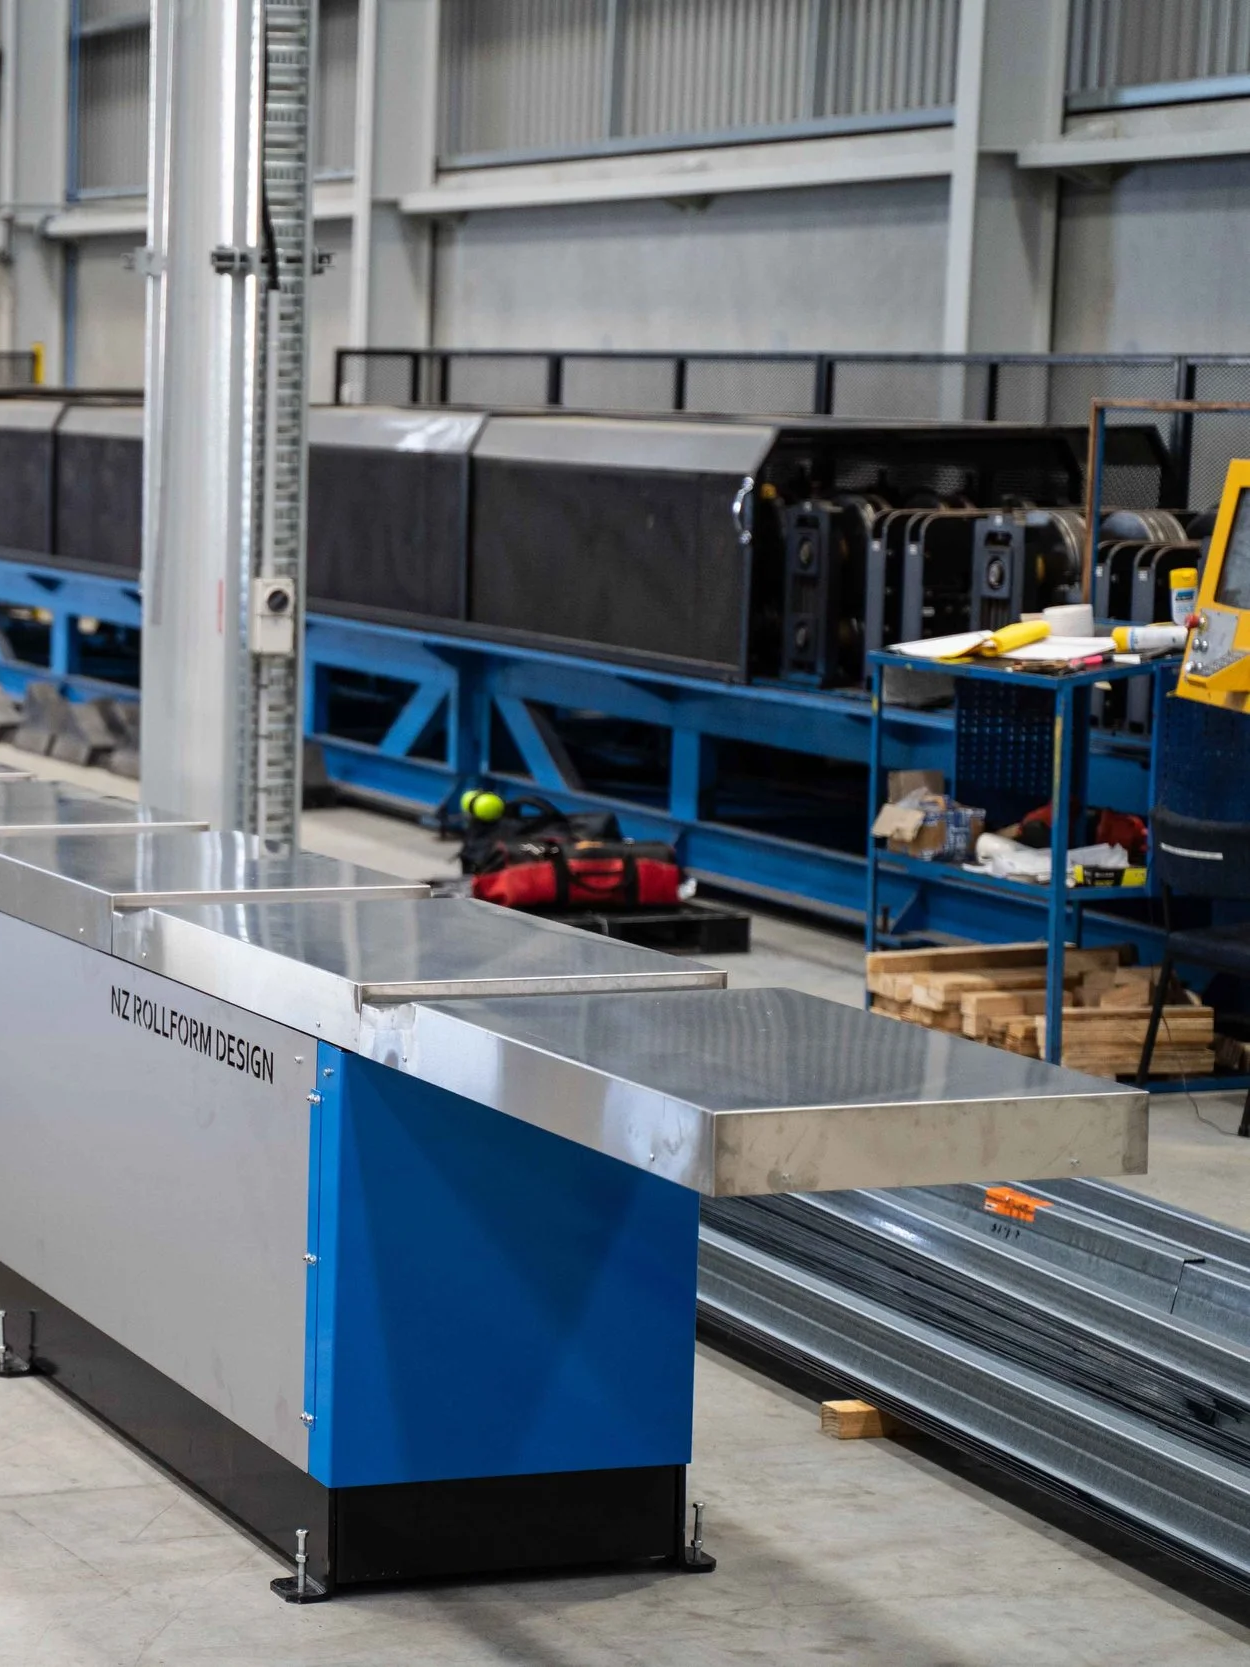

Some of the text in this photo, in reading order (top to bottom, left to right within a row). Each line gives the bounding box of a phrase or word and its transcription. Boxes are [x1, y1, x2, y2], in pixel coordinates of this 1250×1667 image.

[111, 985, 274, 1084] NZ ROLLFORM DESIGN
